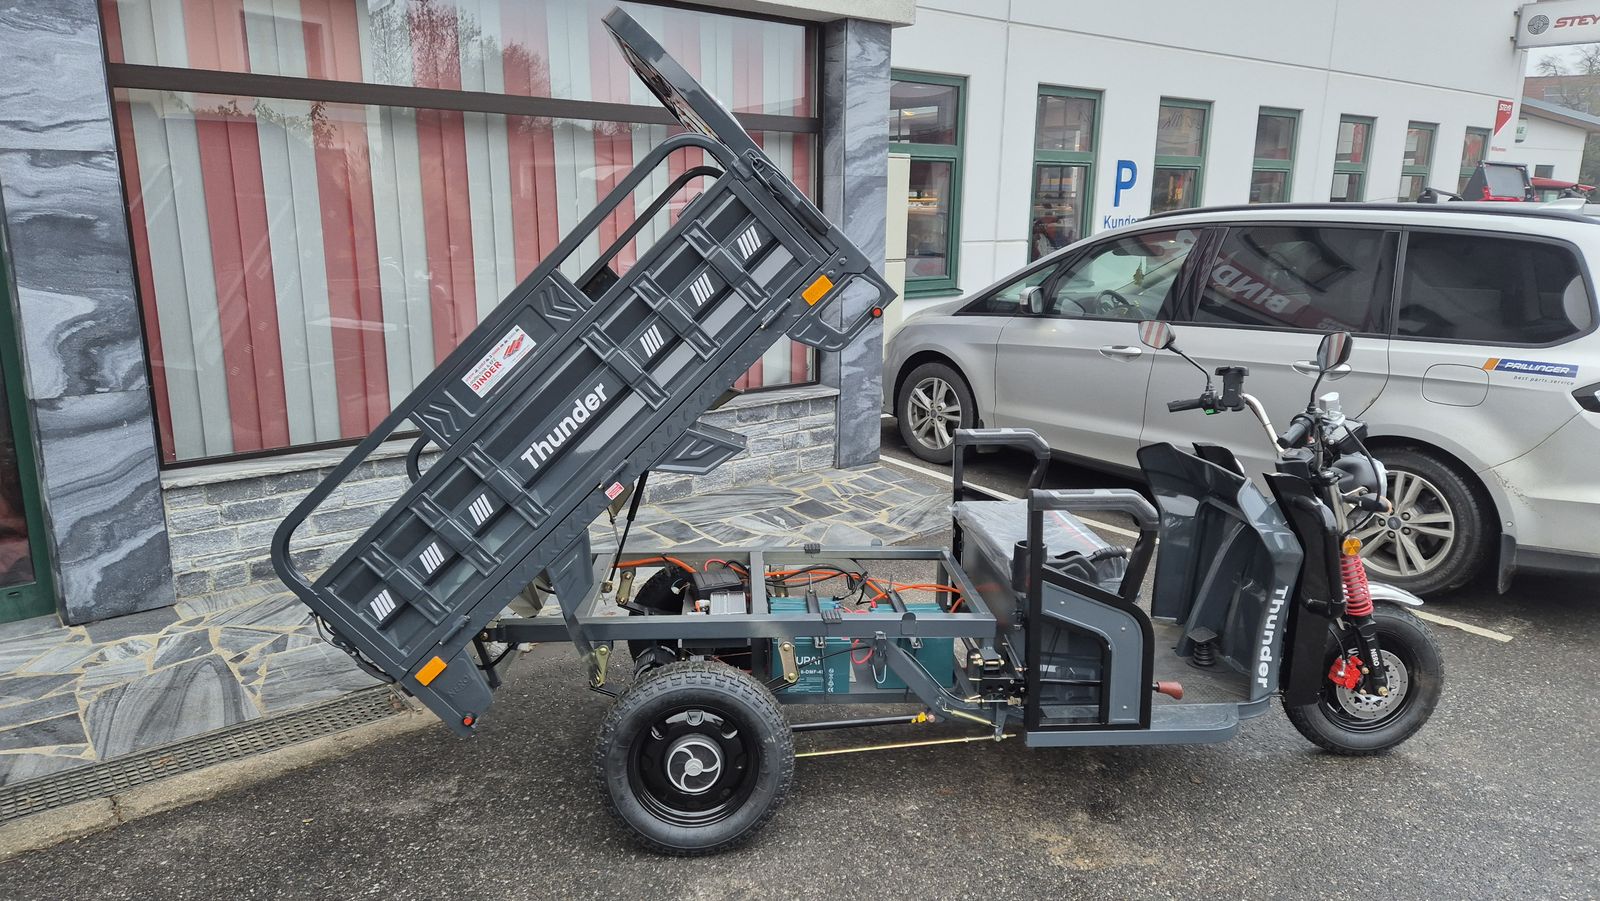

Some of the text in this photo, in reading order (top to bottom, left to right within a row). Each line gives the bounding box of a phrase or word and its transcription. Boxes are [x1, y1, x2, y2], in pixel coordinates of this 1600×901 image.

[1114, 160, 1137, 207] P
[1103, 215, 1137, 229] Kunde
[1504, 362, 1570, 374] PRILLINGER
[520, 382, 607, 470] Thunder
[1257, 585, 1289, 689] Thunder
[1370, 648, 1380, 667] NERO
